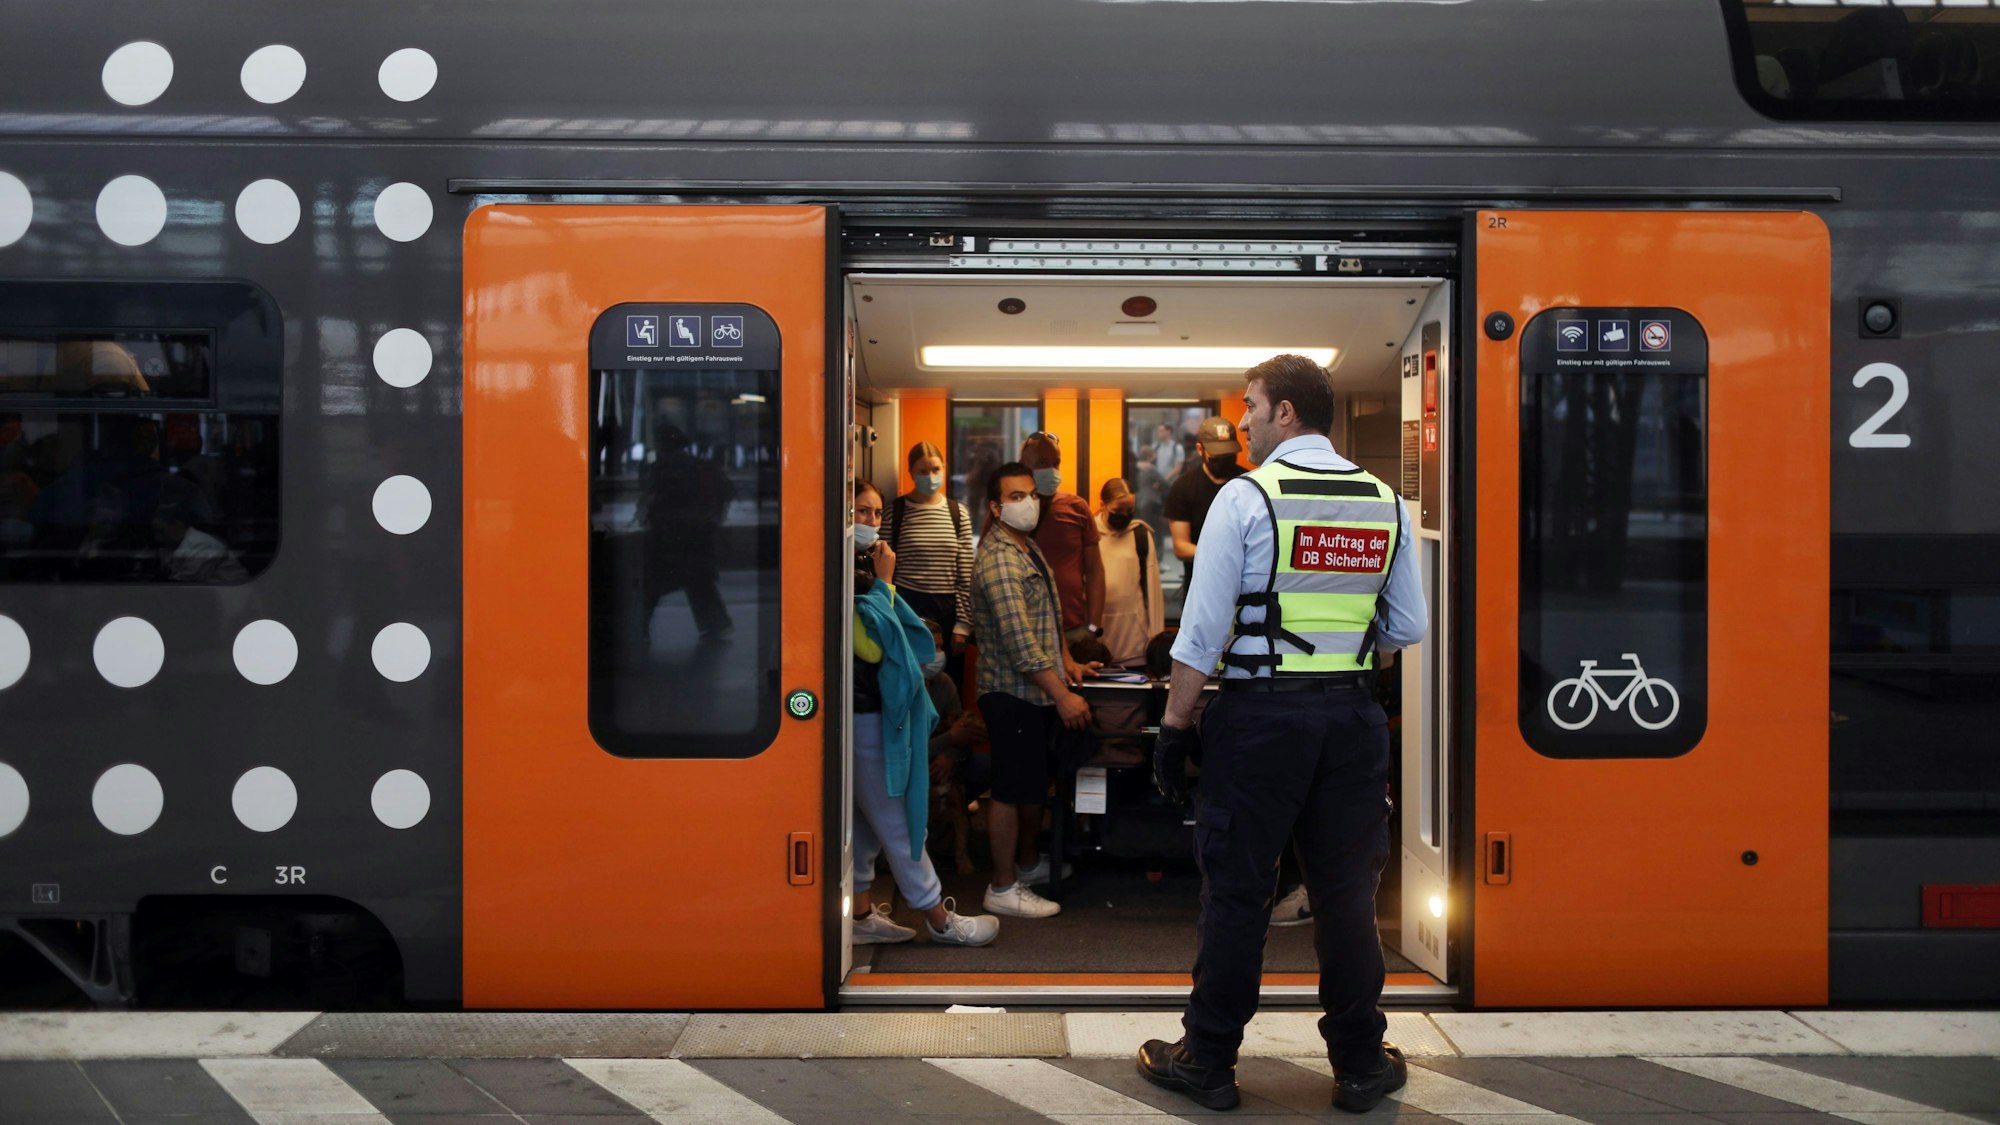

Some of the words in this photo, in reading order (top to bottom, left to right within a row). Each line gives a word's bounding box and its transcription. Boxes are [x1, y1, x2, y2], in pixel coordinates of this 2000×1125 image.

[1488, 217, 1507, 229] 2R
[627, 355, 652, 363] Einstieg
[676, 355, 704, 363] gültigem
[1557, 359, 1581, 367] Einstieg
[1605, 359, 1632, 367] gültigem
[1849, 362, 1911, 448] 2
[1300, 532, 1313, 547] Im
[1318, 533, 1365, 552] Auftrag
[1369, 536, 1386, 550] der
[1302, 550, 1319, 565] DB
[1325, 552, 1381, 568] Sicherheit
[210, 865, 227, 885] C
[274, 865, 306, 885] 3R
